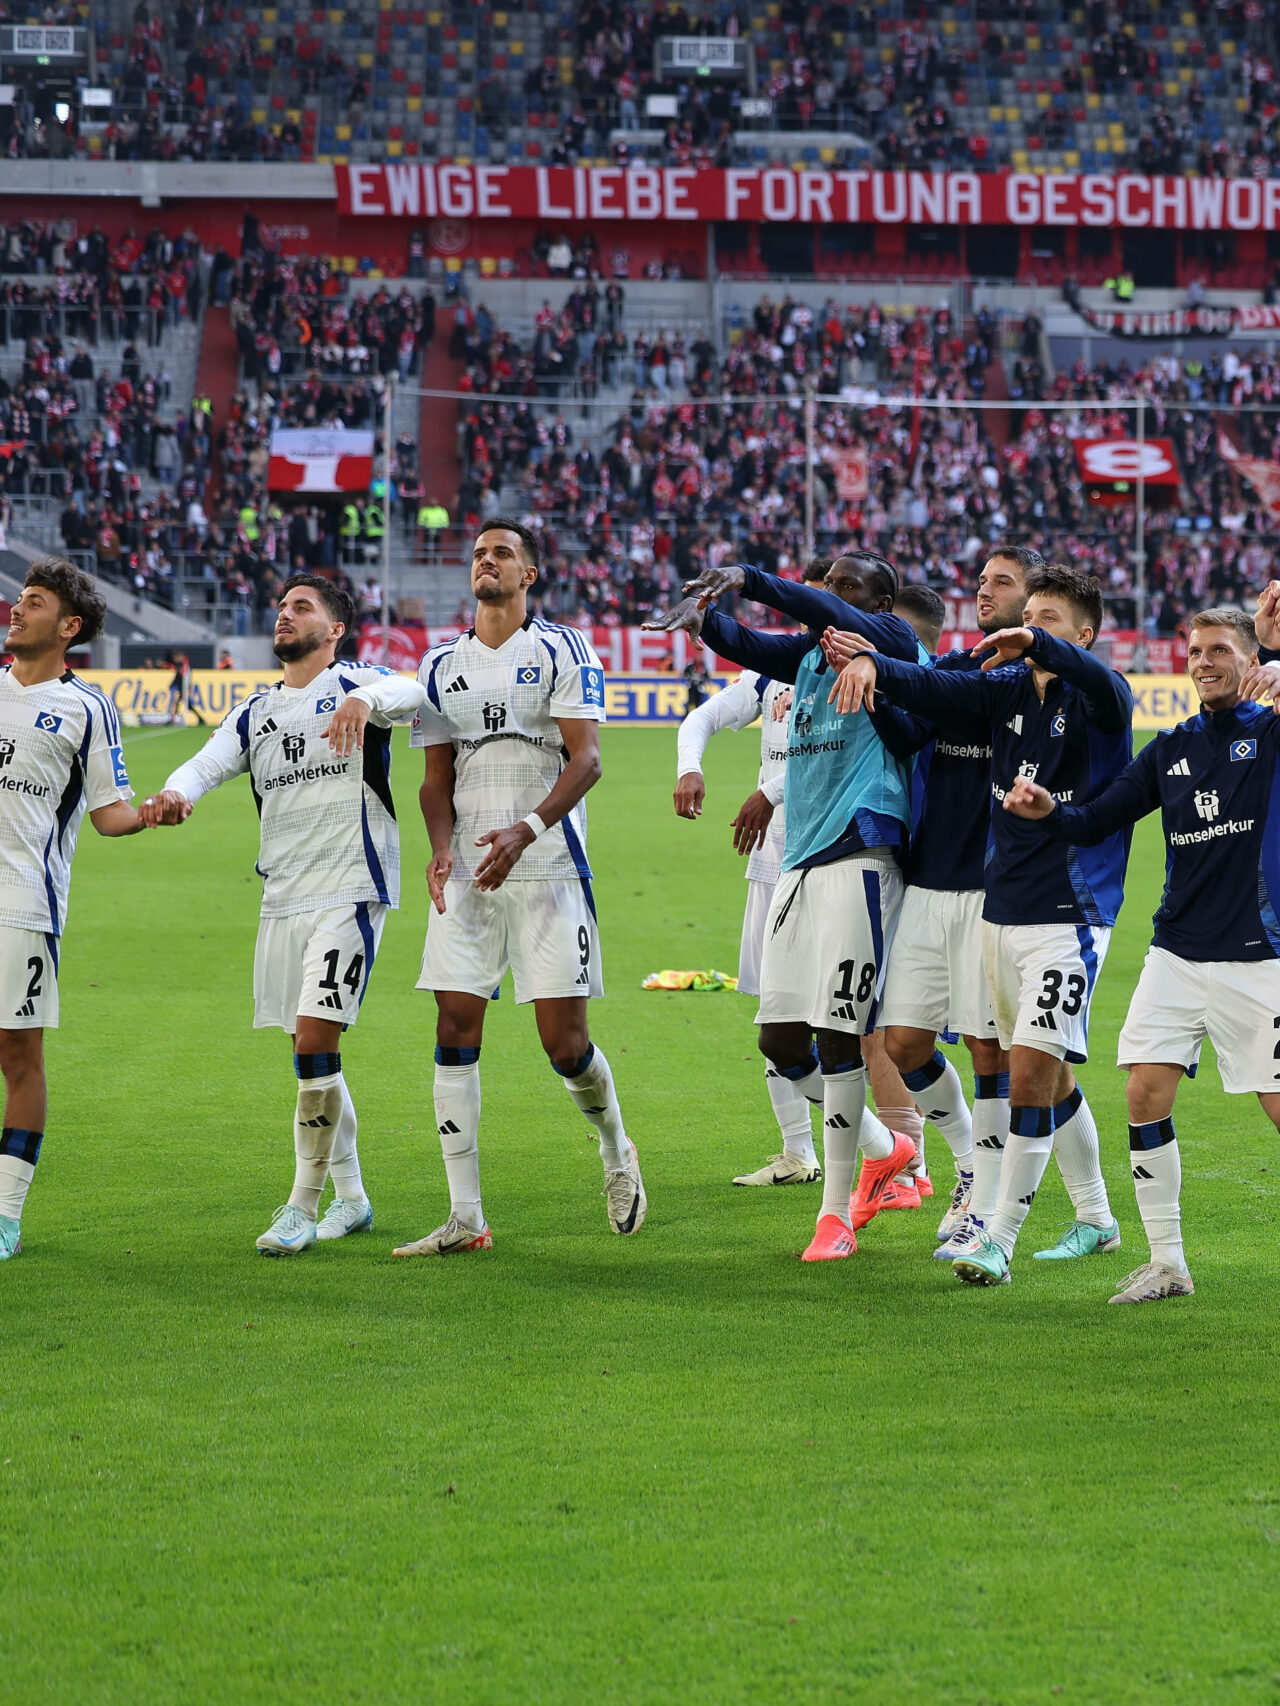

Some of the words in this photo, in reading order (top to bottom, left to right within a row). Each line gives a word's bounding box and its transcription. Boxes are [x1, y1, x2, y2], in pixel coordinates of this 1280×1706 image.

[350, 166, 511, 217] EWIGE
[536, 167, 699, 220] LIEBE
[725, 168, 982, 223] FORTUNA
[577, 925, 590, 966] 9
[27, 956, 44, 998] 2
[318, 948, 365, 996] 14
[833, 959, 876, 1004] 18
[1036, 969, 1086, 1016] 33
